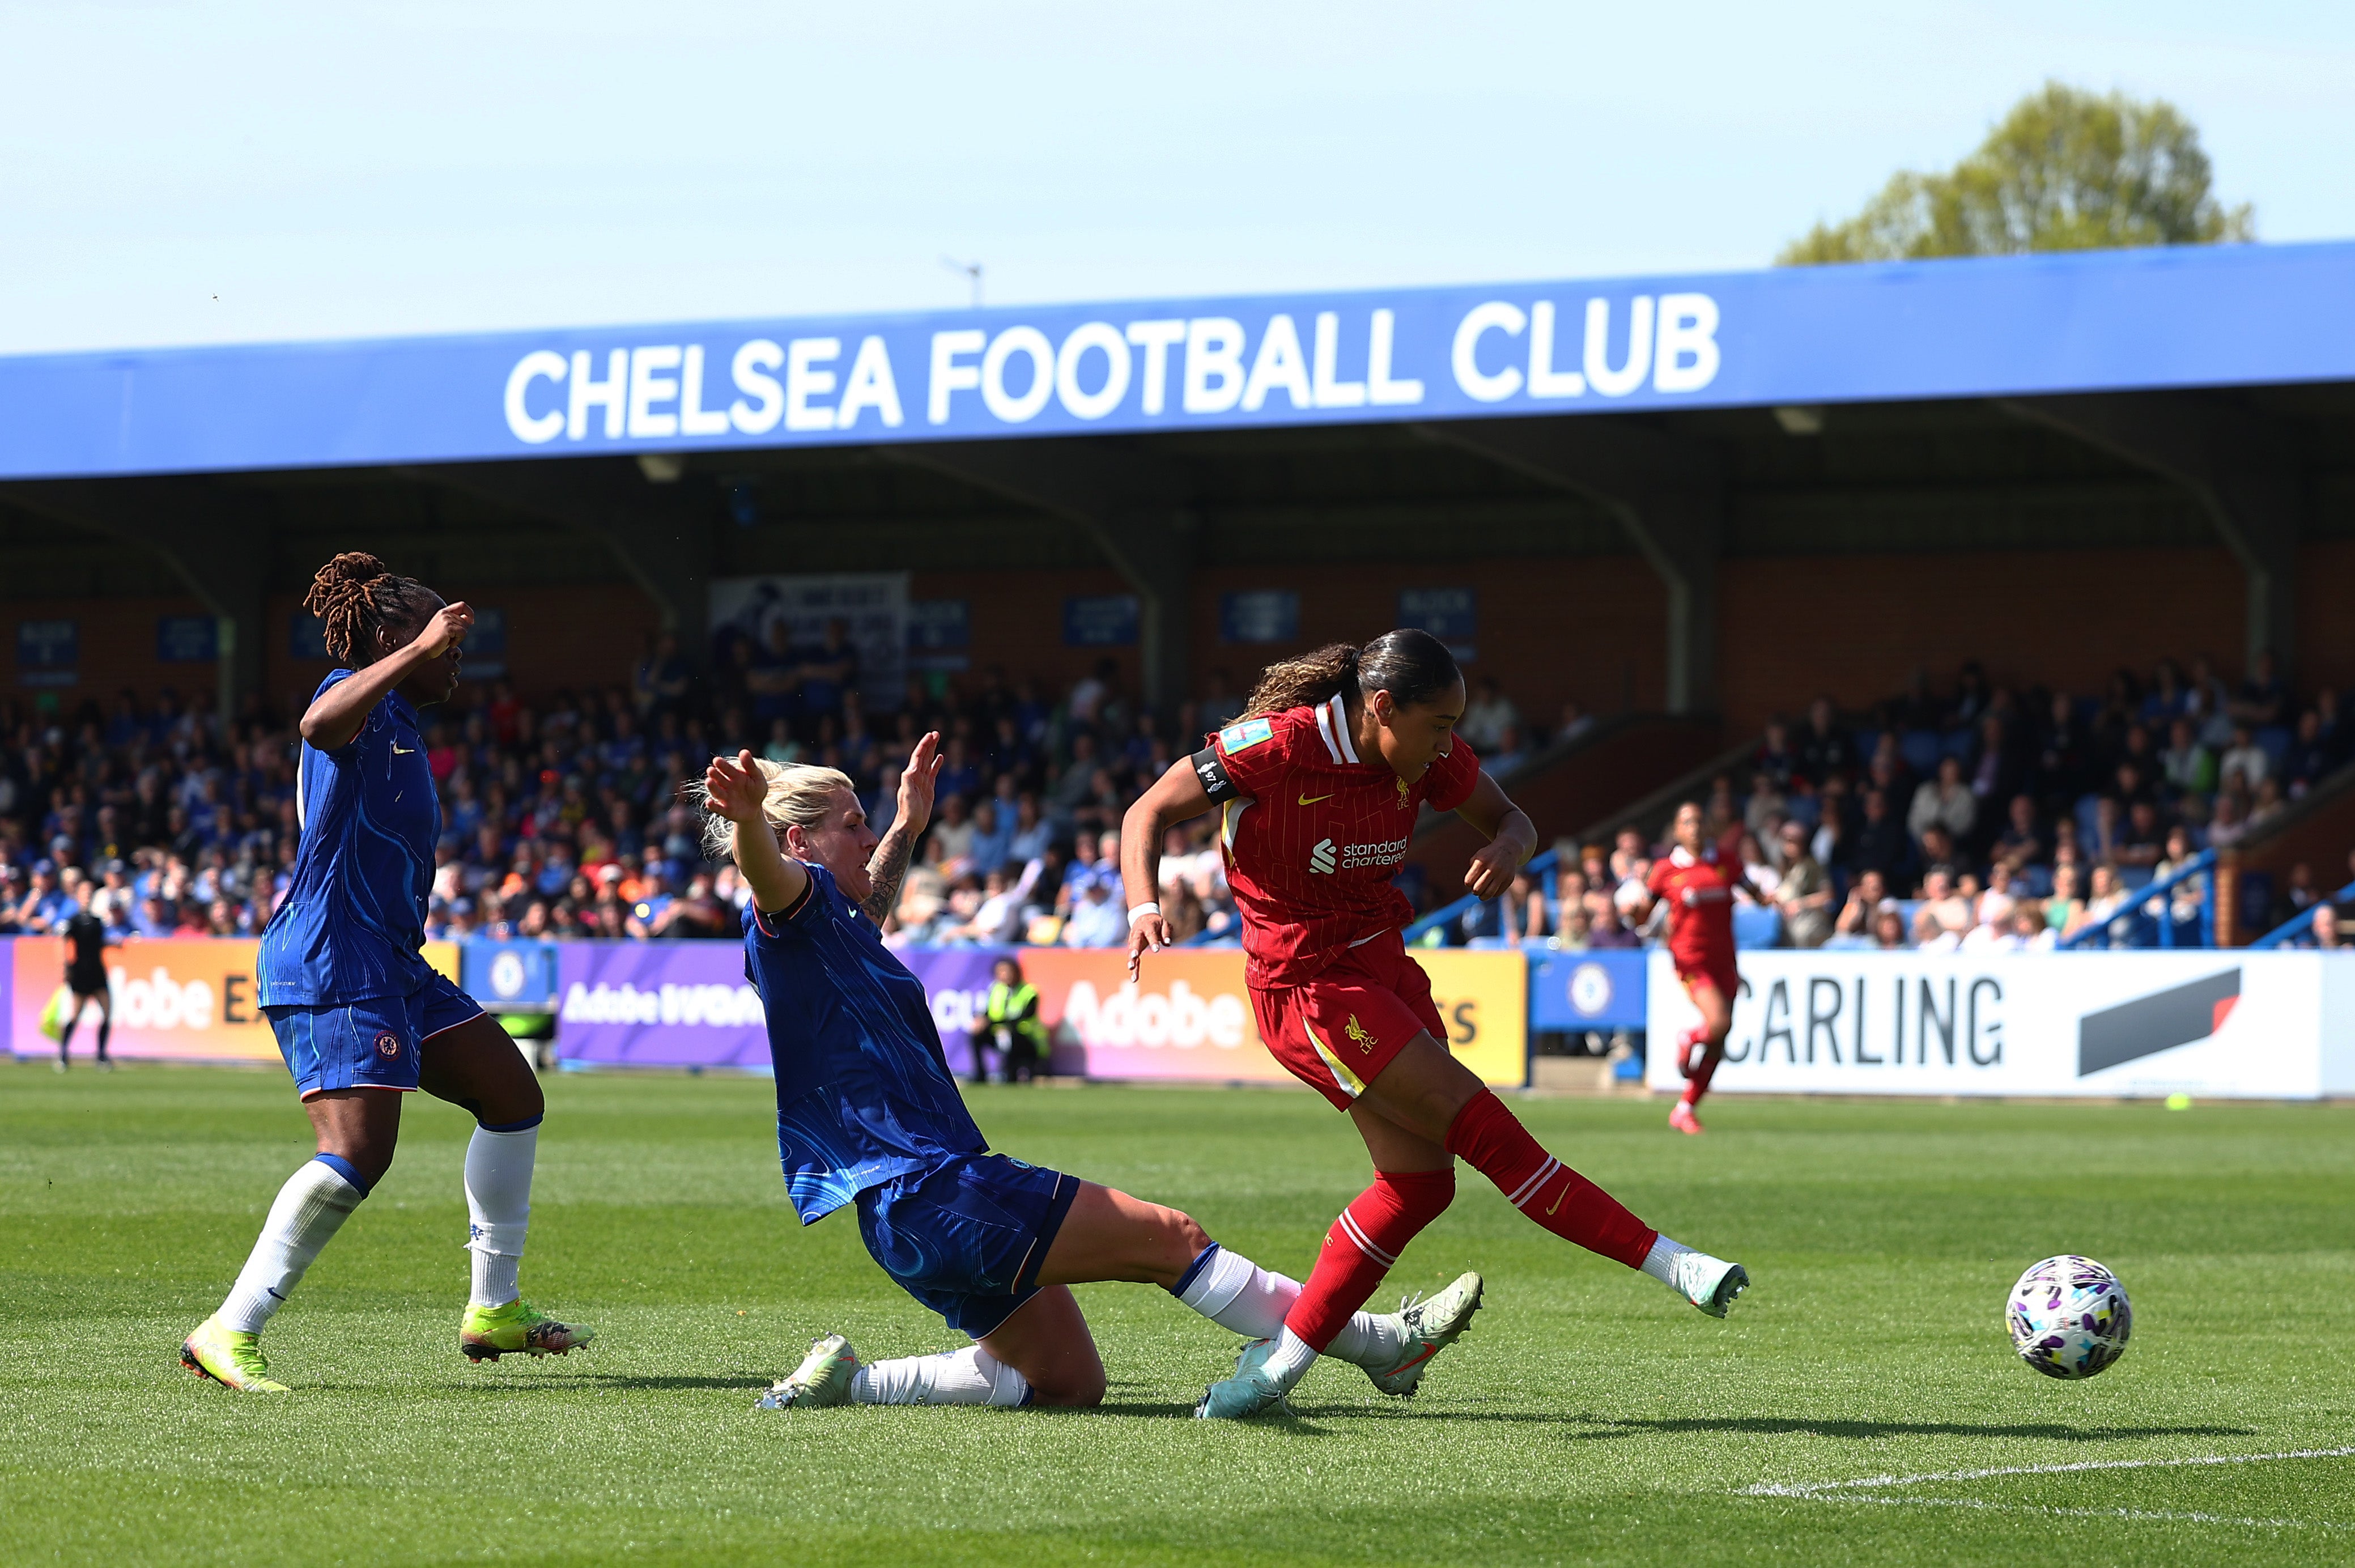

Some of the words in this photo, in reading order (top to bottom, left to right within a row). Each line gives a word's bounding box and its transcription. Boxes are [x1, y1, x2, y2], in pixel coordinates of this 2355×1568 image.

[504, 335, 903, 444] CHELSEA
[928, 309, 1424, 424] FOOTBALL
[1452, 294, 1719, 402] CLUB
[1342, 847, 1407, 869] chartered
[1343, 835, 1408, 857] standard
[562, 981, 659, 1026] Adobe
[1063, 980, 1245, 1048] Adobe
